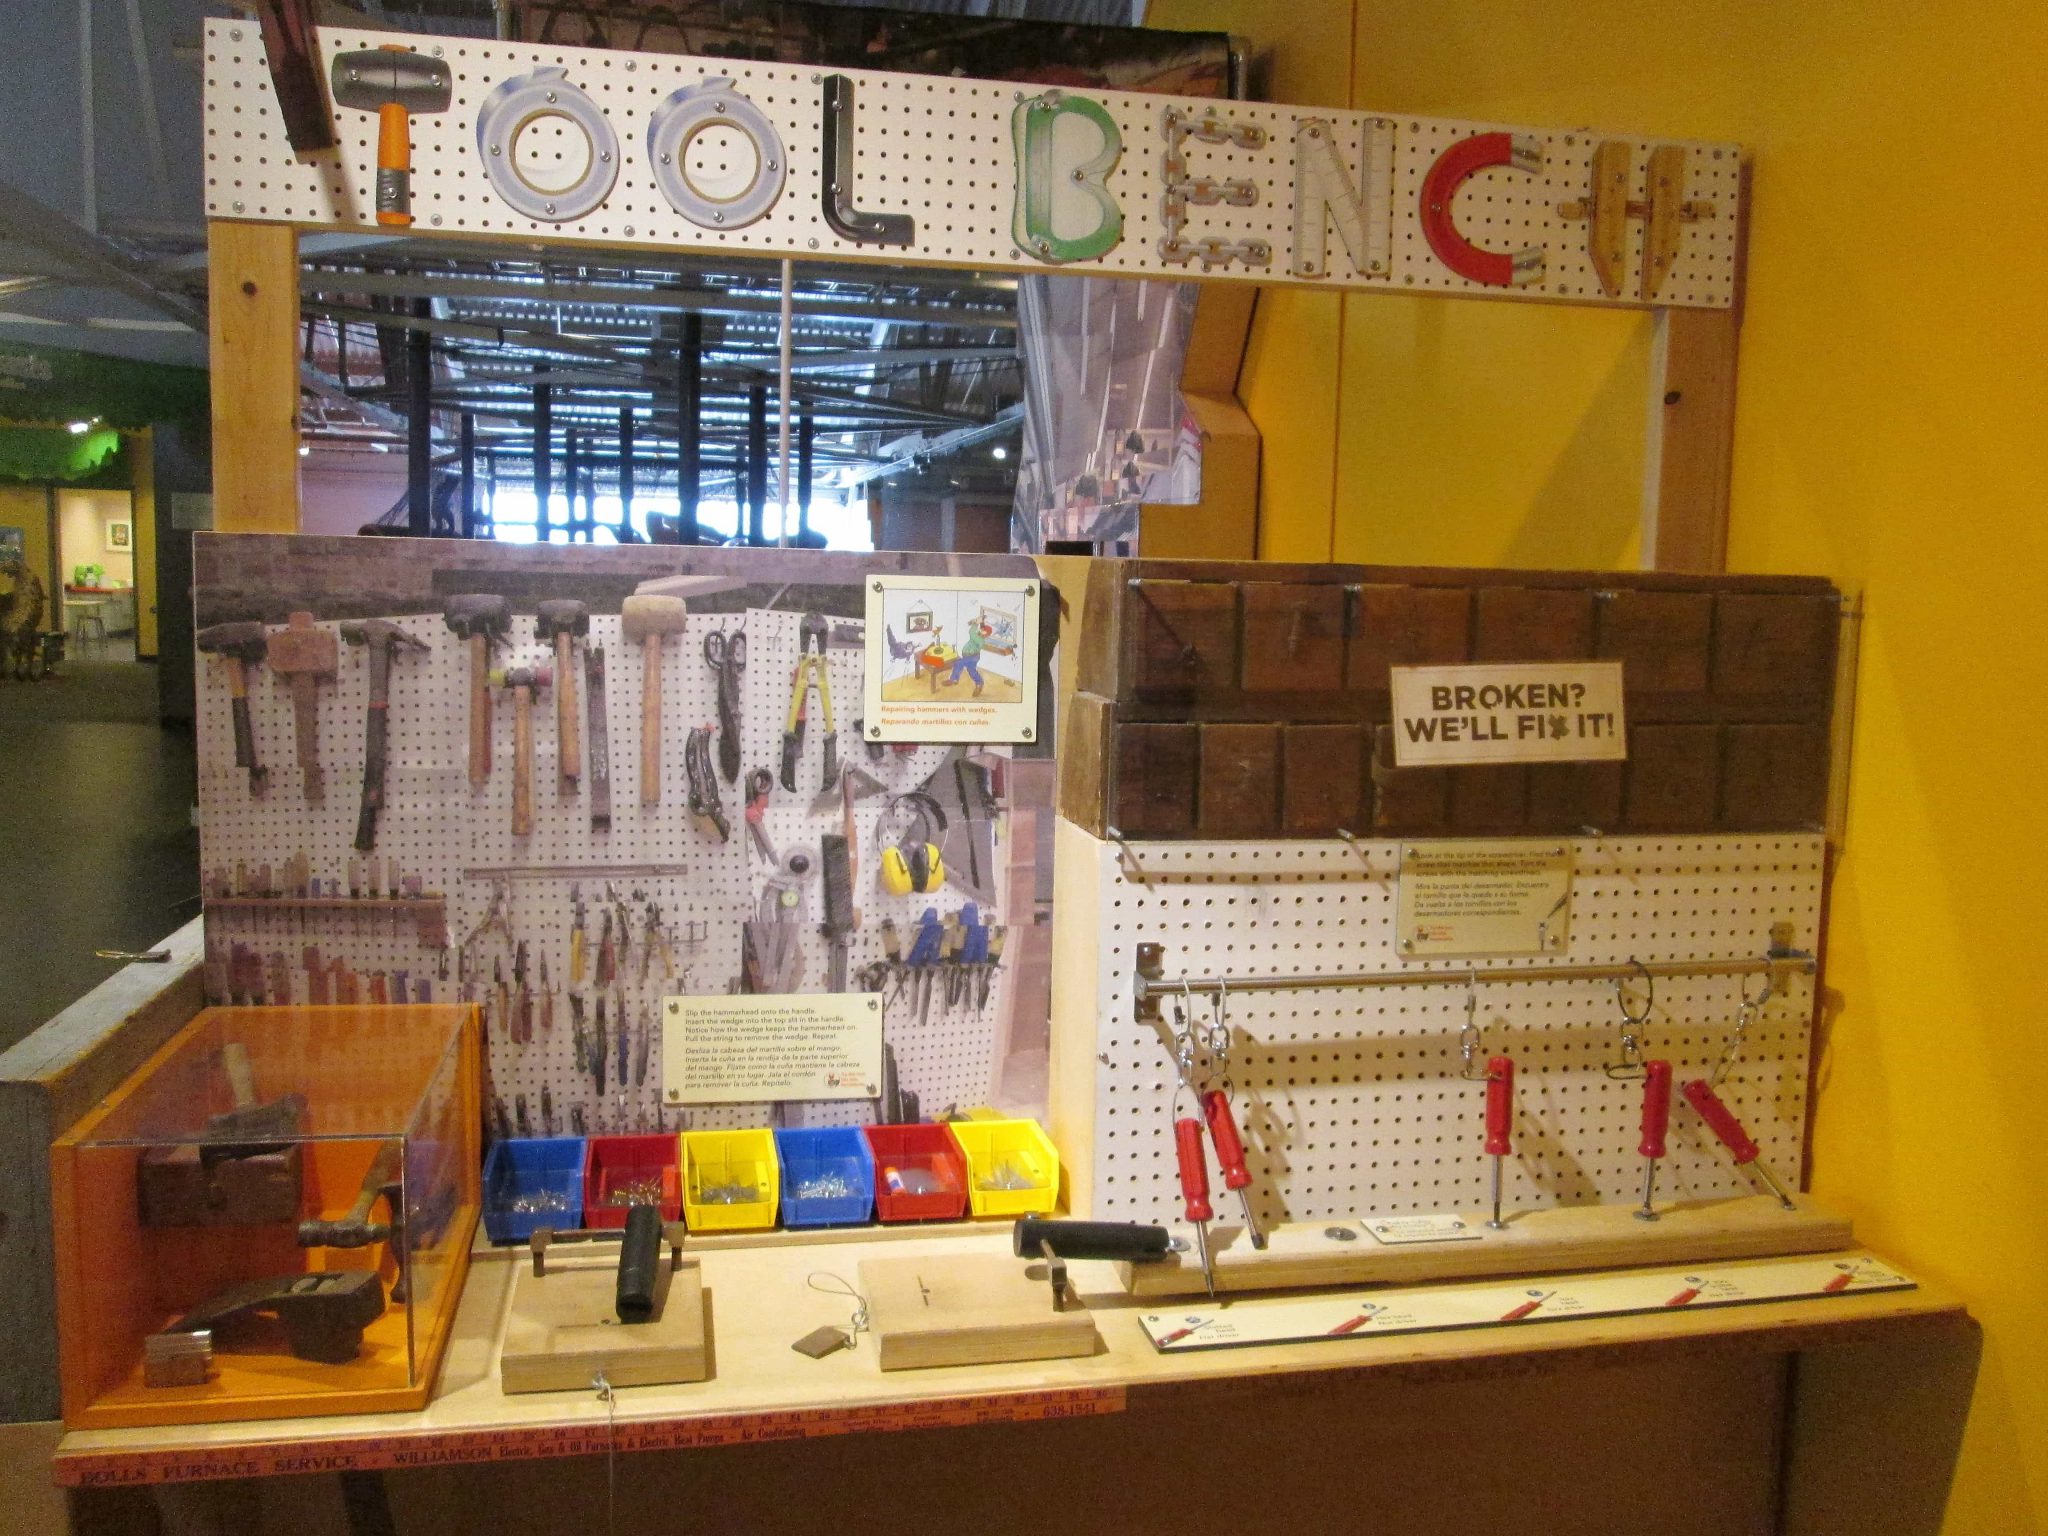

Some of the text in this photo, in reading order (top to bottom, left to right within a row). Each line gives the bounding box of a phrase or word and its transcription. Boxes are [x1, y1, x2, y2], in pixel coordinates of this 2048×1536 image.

[1010, 89, 1715, 299] BENCH
[1431, 682, 1586, 711] BROKEN?
[881, 705, 915, 714] Repairing
[968, 706, 998, 714] wedges.
[881, 718, 919, 726] Reparando
[1404, 712, 1615, 743] WE'LL FIX IT!
[686, 1009, 698, 1017] Slip
[720, 1017, 743, 1025] wedge
[163, 1461, 258, 1479] FURNACE
[274, 1454, 358, 1472] SERVICE
[394, 1447, 492, 1465] WILLIAMSON
[640, 1435, 668, 1448] Electric
[674, 1430, 692, 1446] Heat
[741, 1428, 753, 1440] Air
